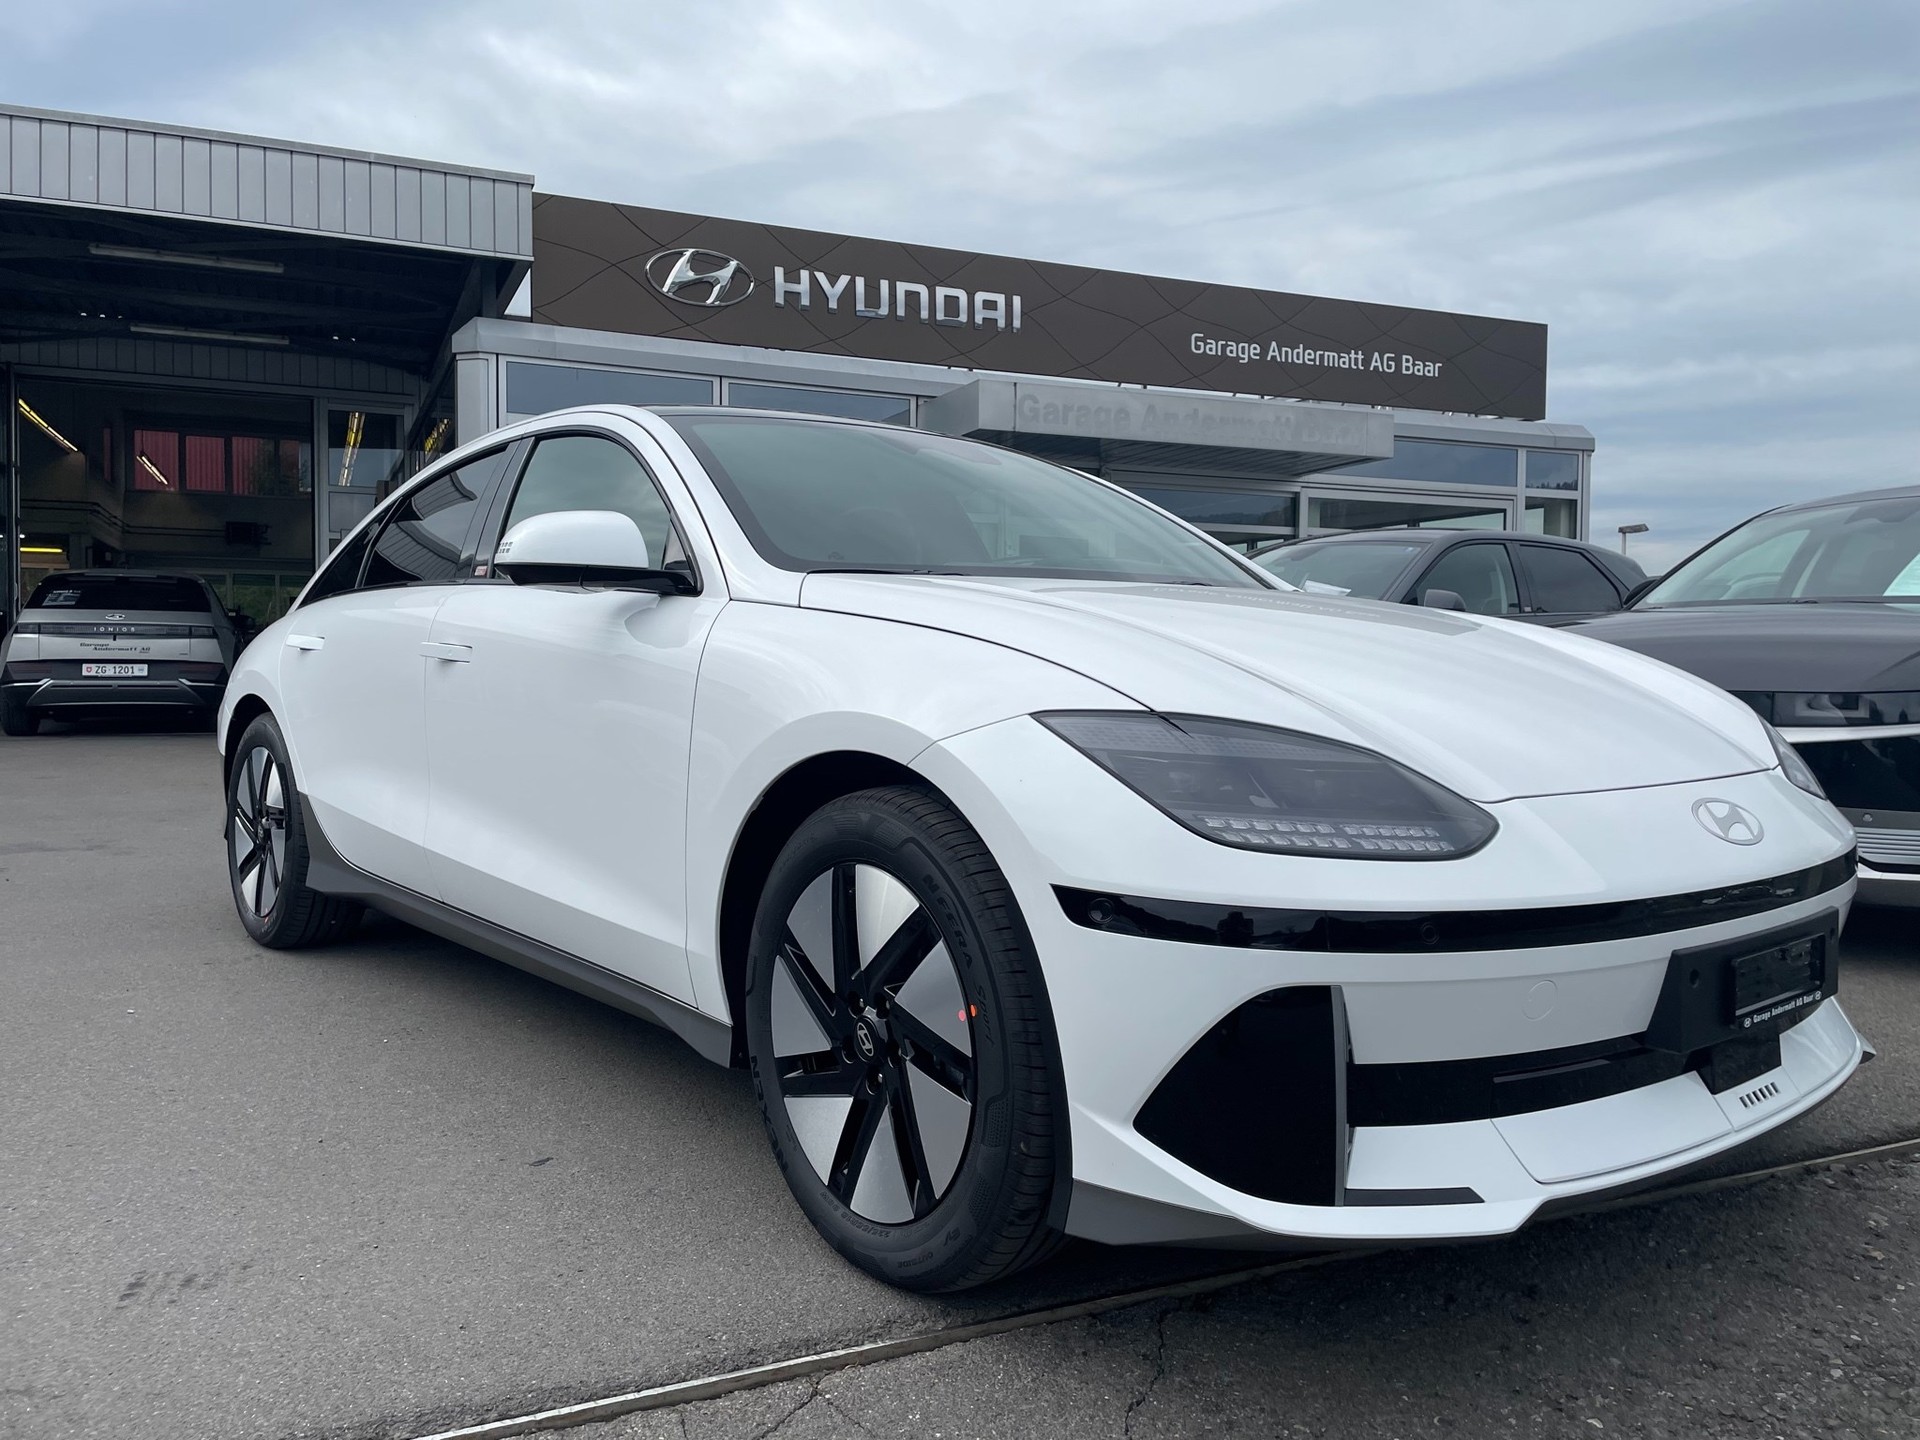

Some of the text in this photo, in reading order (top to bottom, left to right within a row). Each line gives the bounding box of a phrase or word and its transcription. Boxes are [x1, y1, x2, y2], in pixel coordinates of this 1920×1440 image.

[774, 266, 1022, 333] HYUNDAI
[1190, 333, 1443, 377] Garage Andermatt AG Baar
[1018, 393, 1131, 431] Garage
[95, 665, 107, 674] ZG
[112, 665, 135, 675] 1201
[1753, 1010, 1771, 1023] Garage
[1771, 1000, 1796, 1016] Andermatt
[1796, 997, 1803, 1007] AG
[751, 1055, 789, 1173] NEXEN
